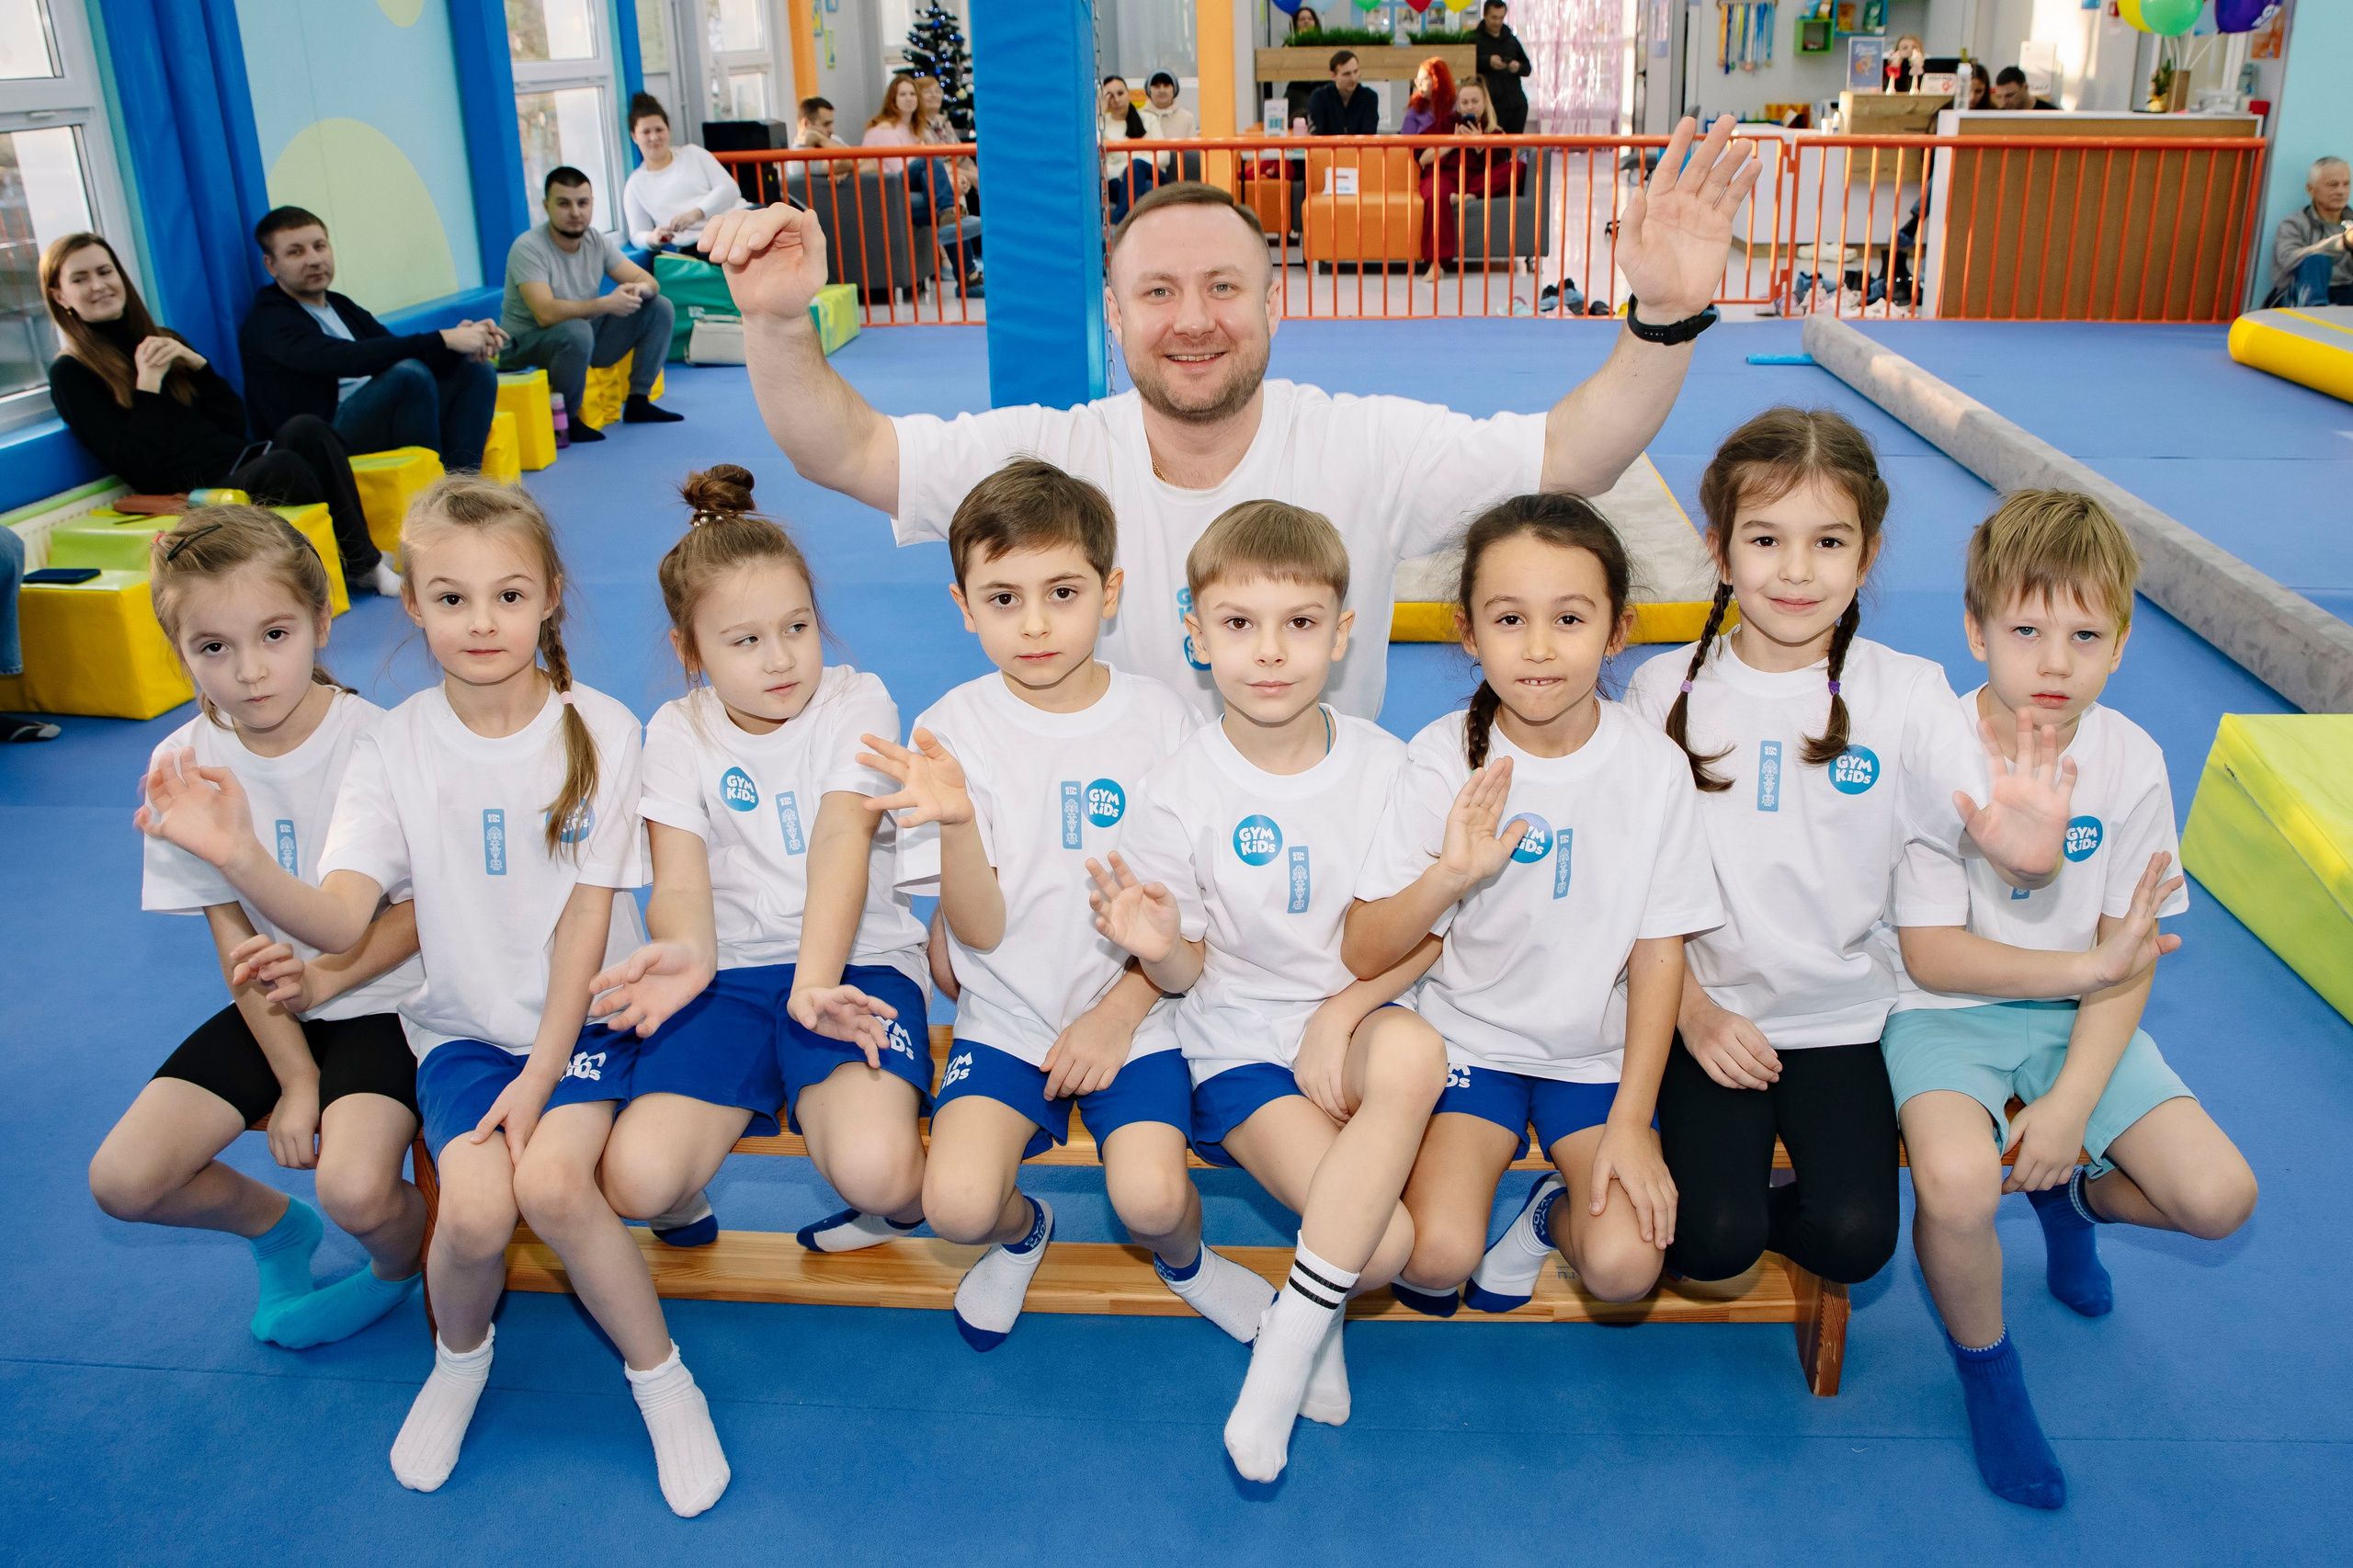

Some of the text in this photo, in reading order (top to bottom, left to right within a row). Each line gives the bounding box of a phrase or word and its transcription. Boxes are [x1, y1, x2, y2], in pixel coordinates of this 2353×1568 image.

[1836, 755, 1872, 772] GYM
[726, 775, 754, 792] GYM
[1088, 788, 1120, 805] GYM
[1238, 826, 1275, 842] GYM
[2066, 826, 2097, 841] GYM
[875, 1016, 913, 1046] YM
